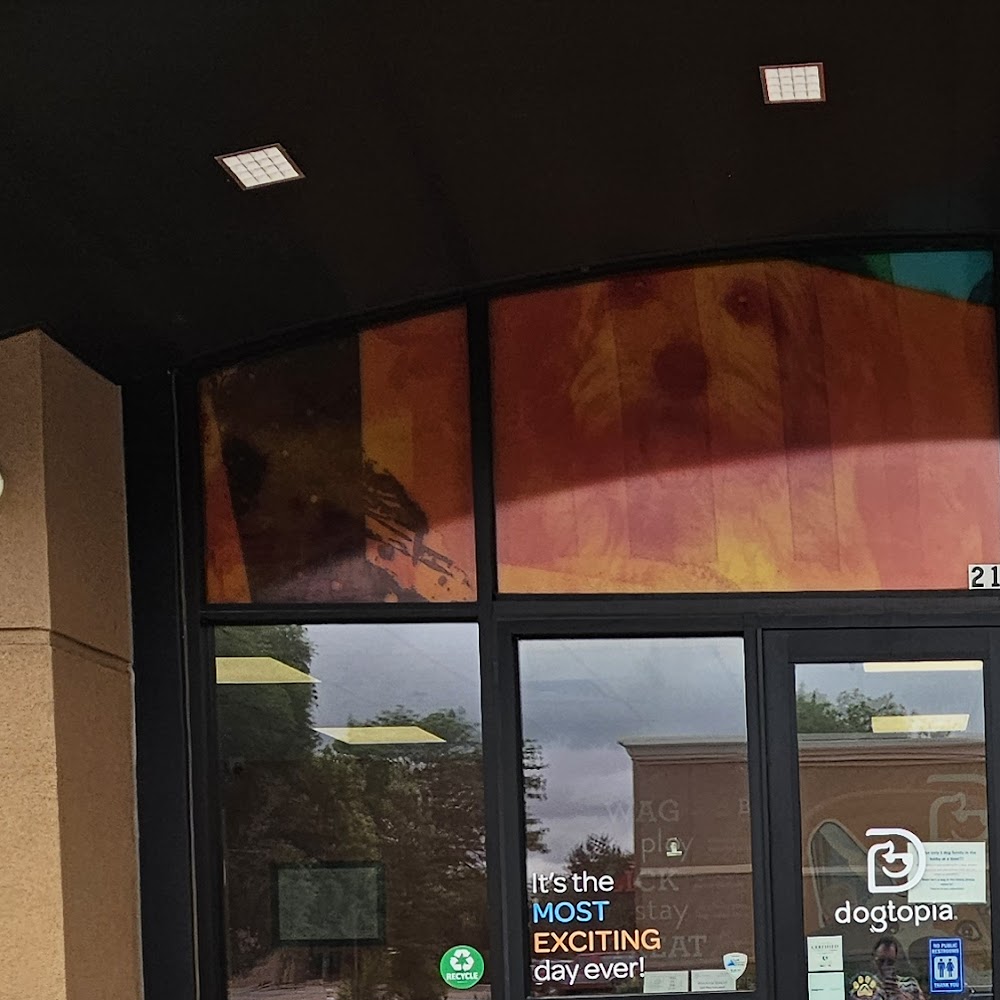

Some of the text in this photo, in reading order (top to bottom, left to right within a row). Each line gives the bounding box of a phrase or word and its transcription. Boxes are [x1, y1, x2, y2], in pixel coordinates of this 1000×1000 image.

[971, 566, 1000, 587] 21
[532, 870, 615, 894] It's the
[533, 901, 610, 923] MOST
[834, 900, 954, 933] dogtopia
[534, 928, 661, 953] EXCITING
[446, 972, 479, 980] RECYCLE
[534, 956, 645, 985] day ever!
